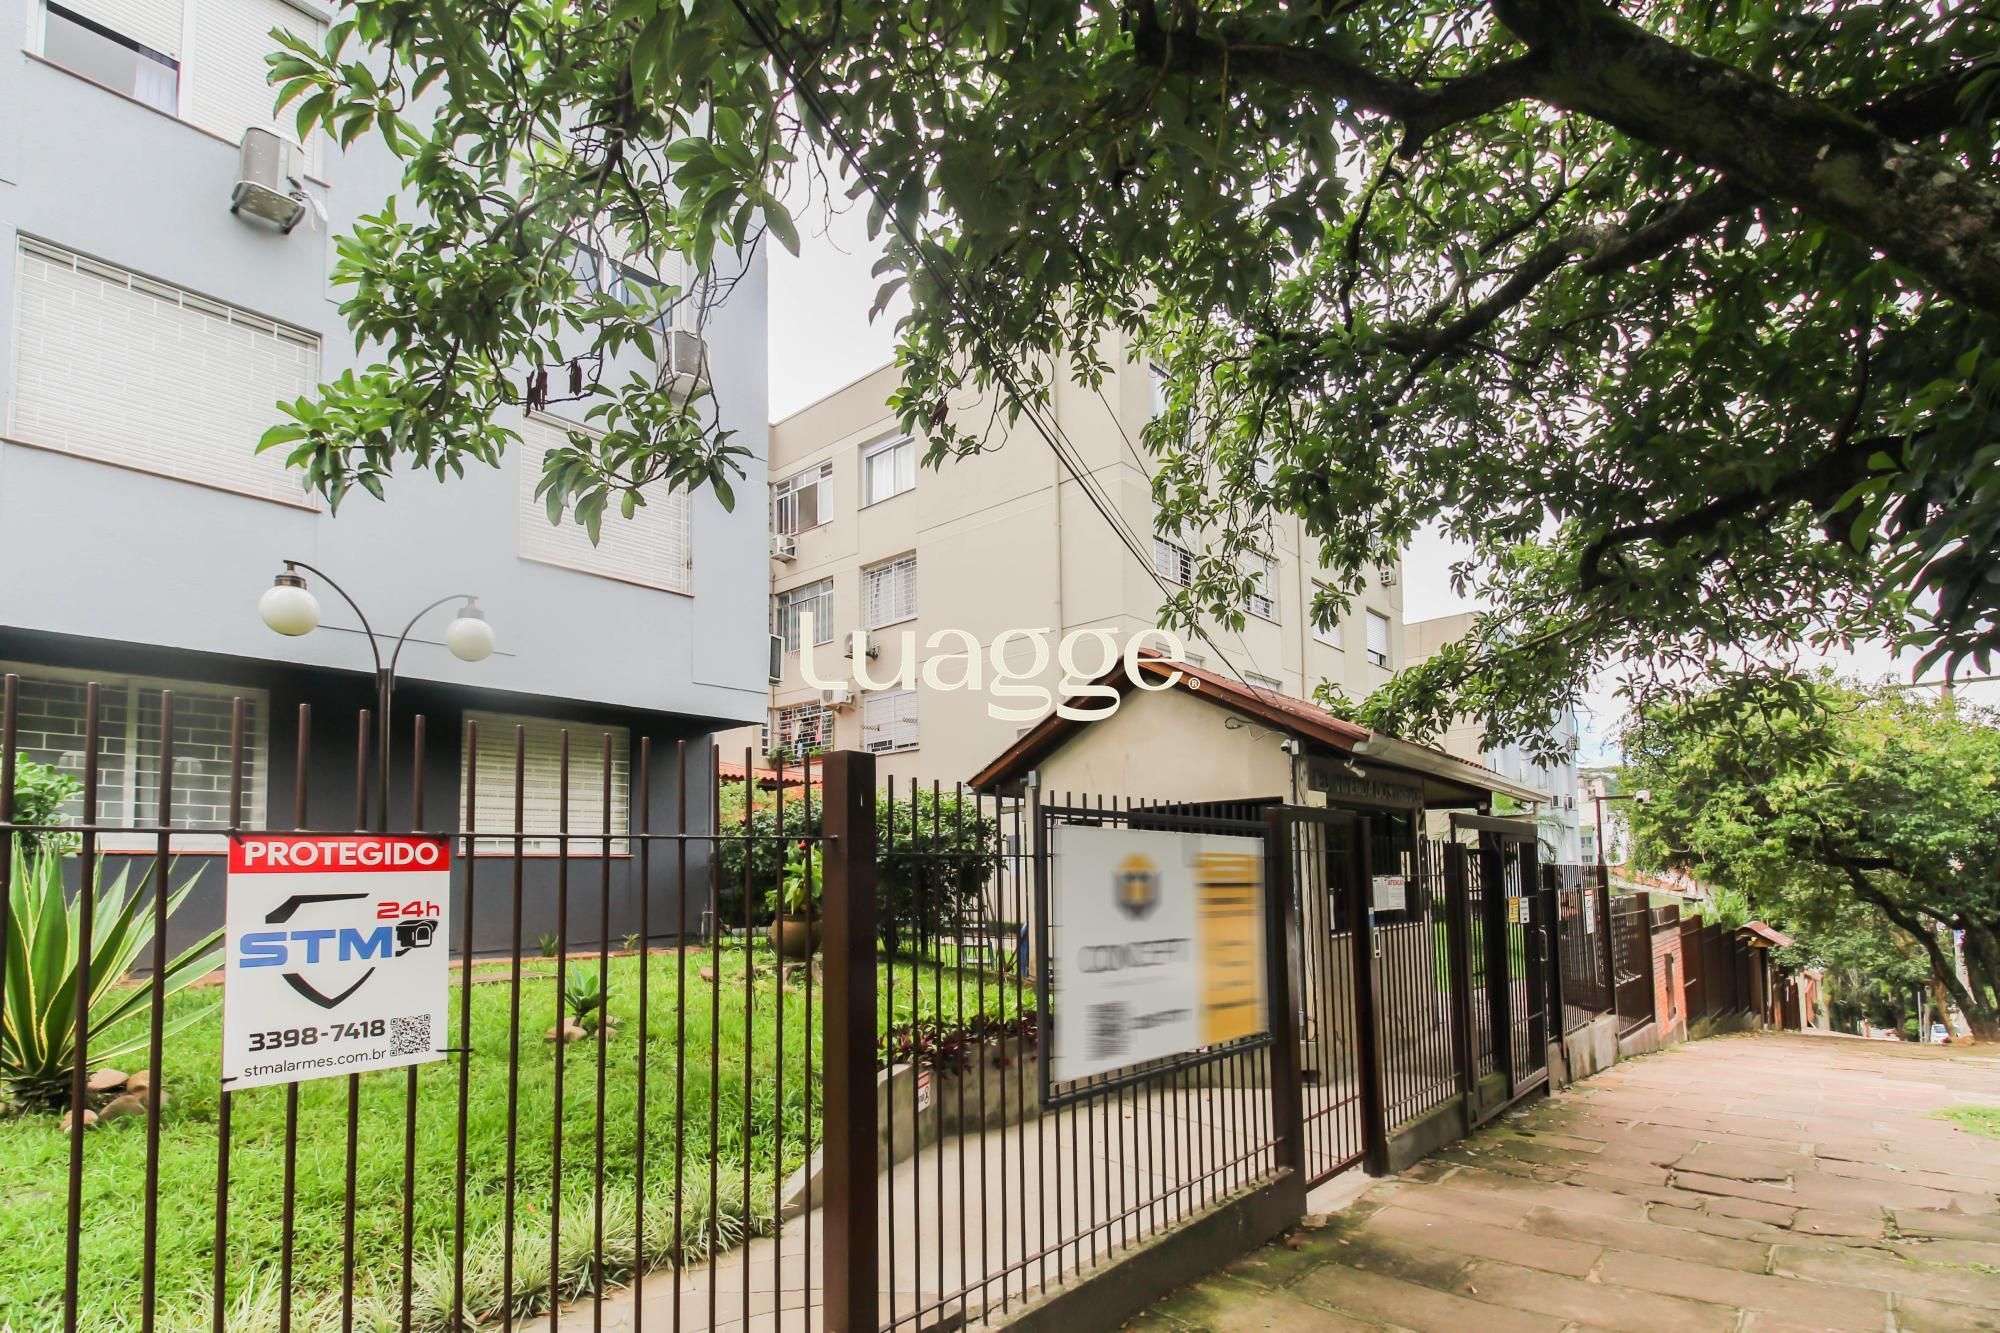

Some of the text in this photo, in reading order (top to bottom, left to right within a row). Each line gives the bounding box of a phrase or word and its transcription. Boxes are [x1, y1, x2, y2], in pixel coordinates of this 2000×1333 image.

[244, 841, 439, 866] PROTEGIDO
[376, 901, 440, 919] 24h
[239, 926, 393, 968] STM
[248, 1019, 386, 1052] 3398-7418
[244, 1048, 387, 1077] stmalarmes.com.br
